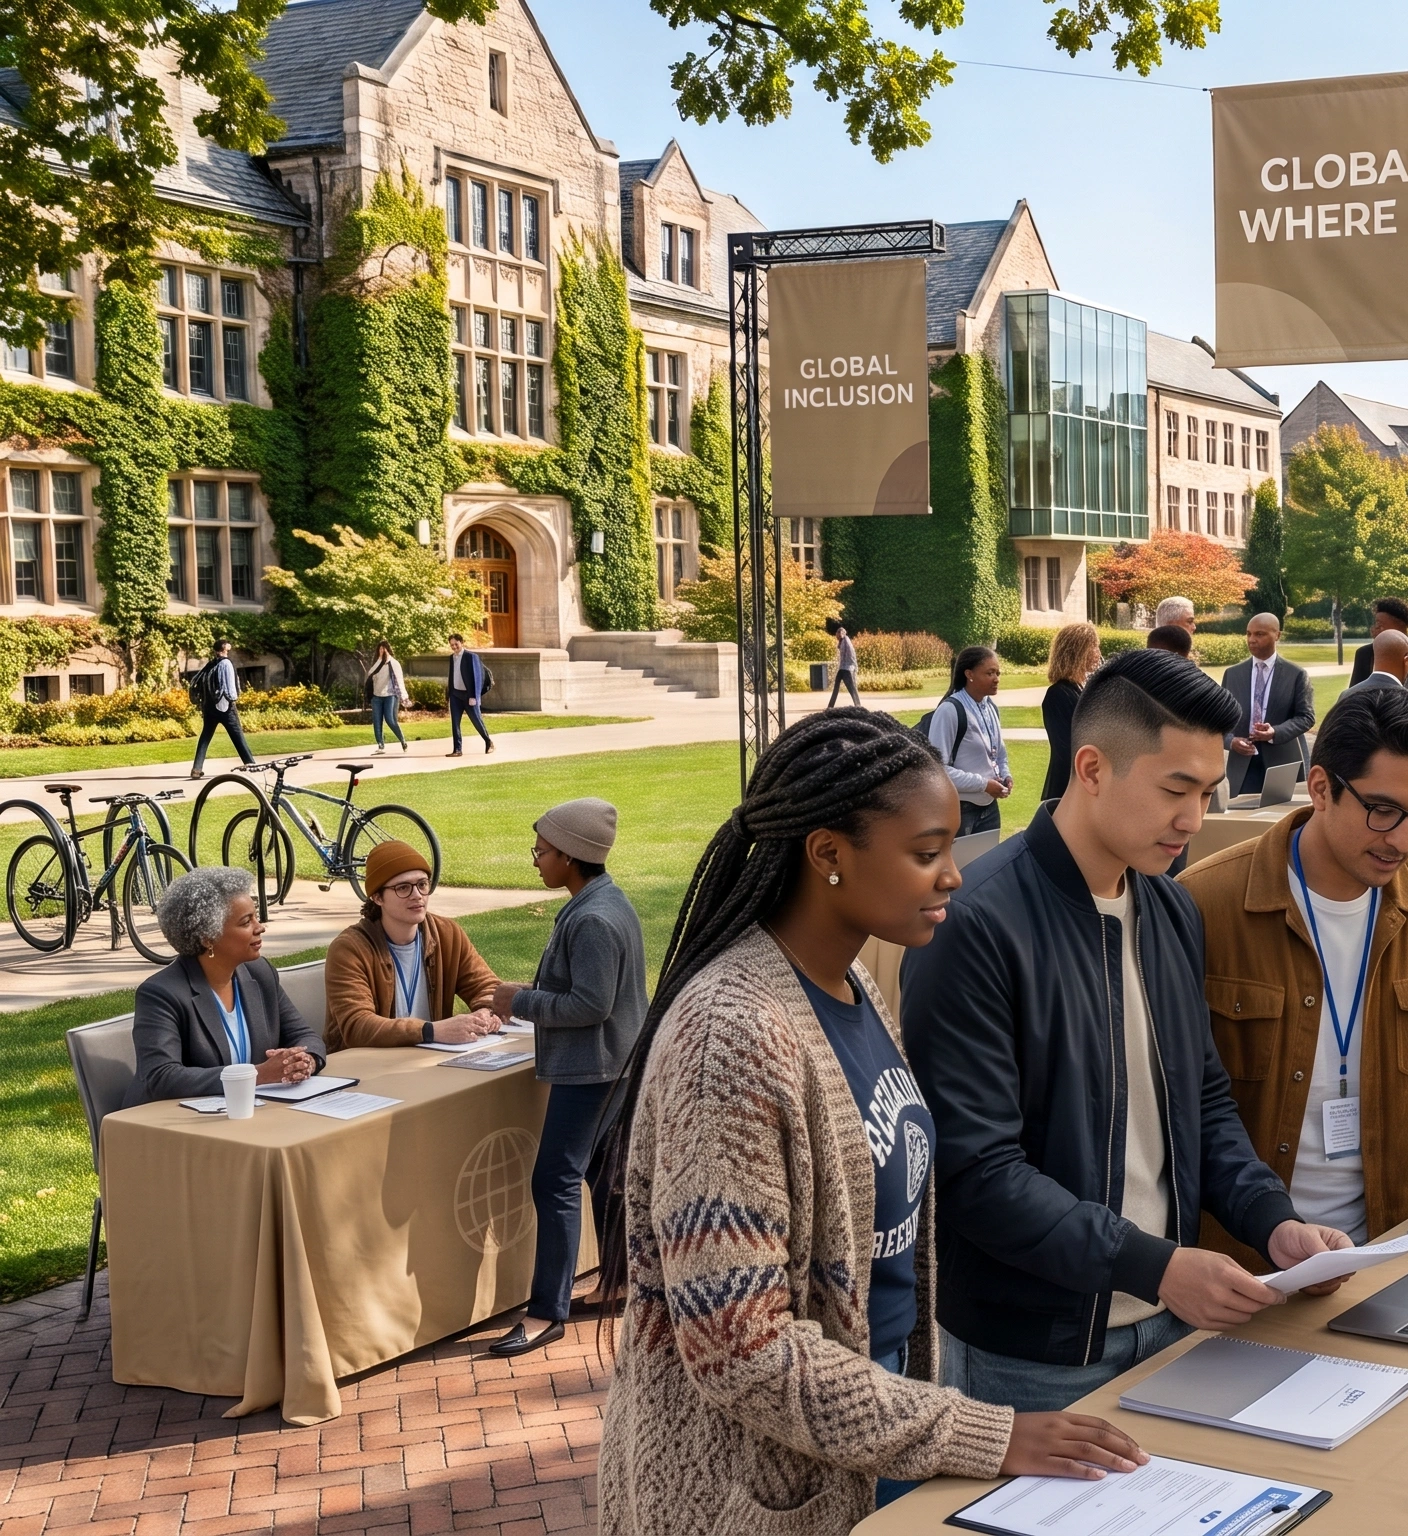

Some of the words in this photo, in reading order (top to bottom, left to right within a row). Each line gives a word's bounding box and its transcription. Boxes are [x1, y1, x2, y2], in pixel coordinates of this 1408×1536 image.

[1238, 199, 1397, 243] WHERE
[800, 354, 898, 380] GLOBAL
[784, 382, 913, 409] INCLUSION
